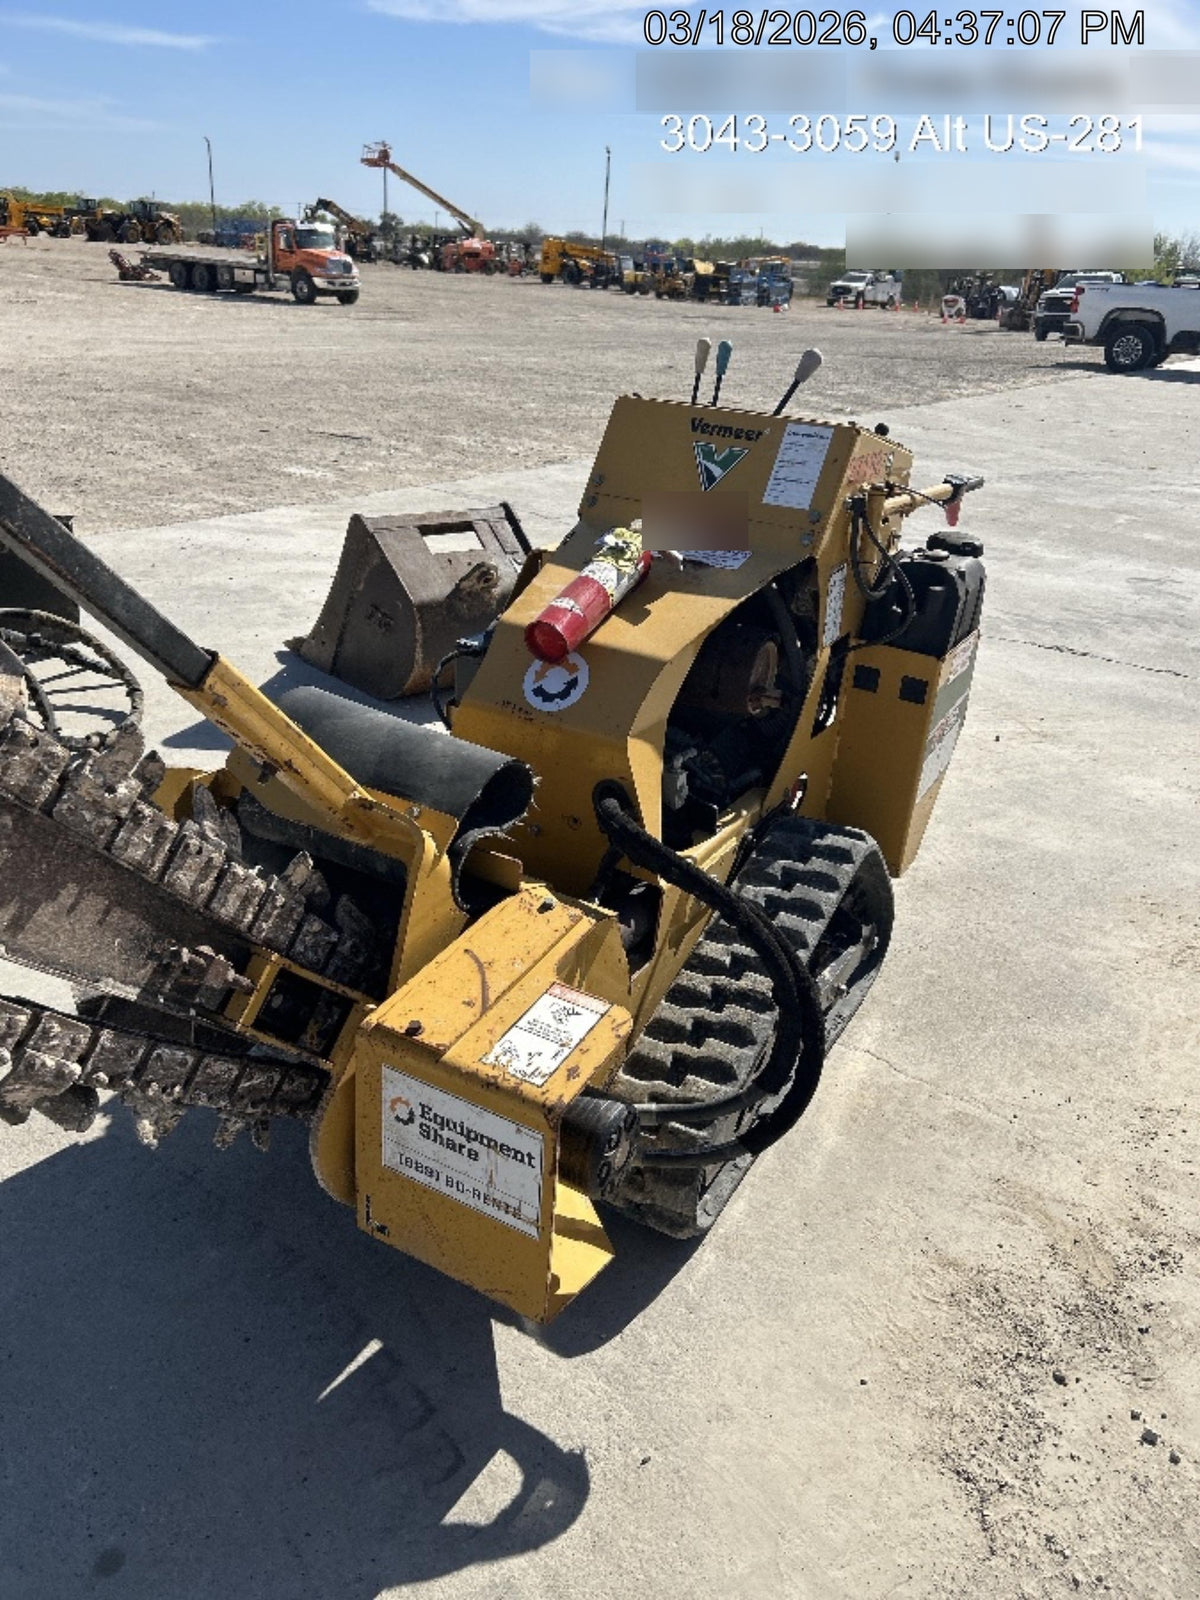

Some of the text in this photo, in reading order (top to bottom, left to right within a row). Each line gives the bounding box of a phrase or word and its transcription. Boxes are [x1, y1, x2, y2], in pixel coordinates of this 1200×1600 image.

[690, 417, 763, 442] Vermeer
[418, 1101, 536, 1169] Equipment
[418, 1121, 480, 1162] Share
